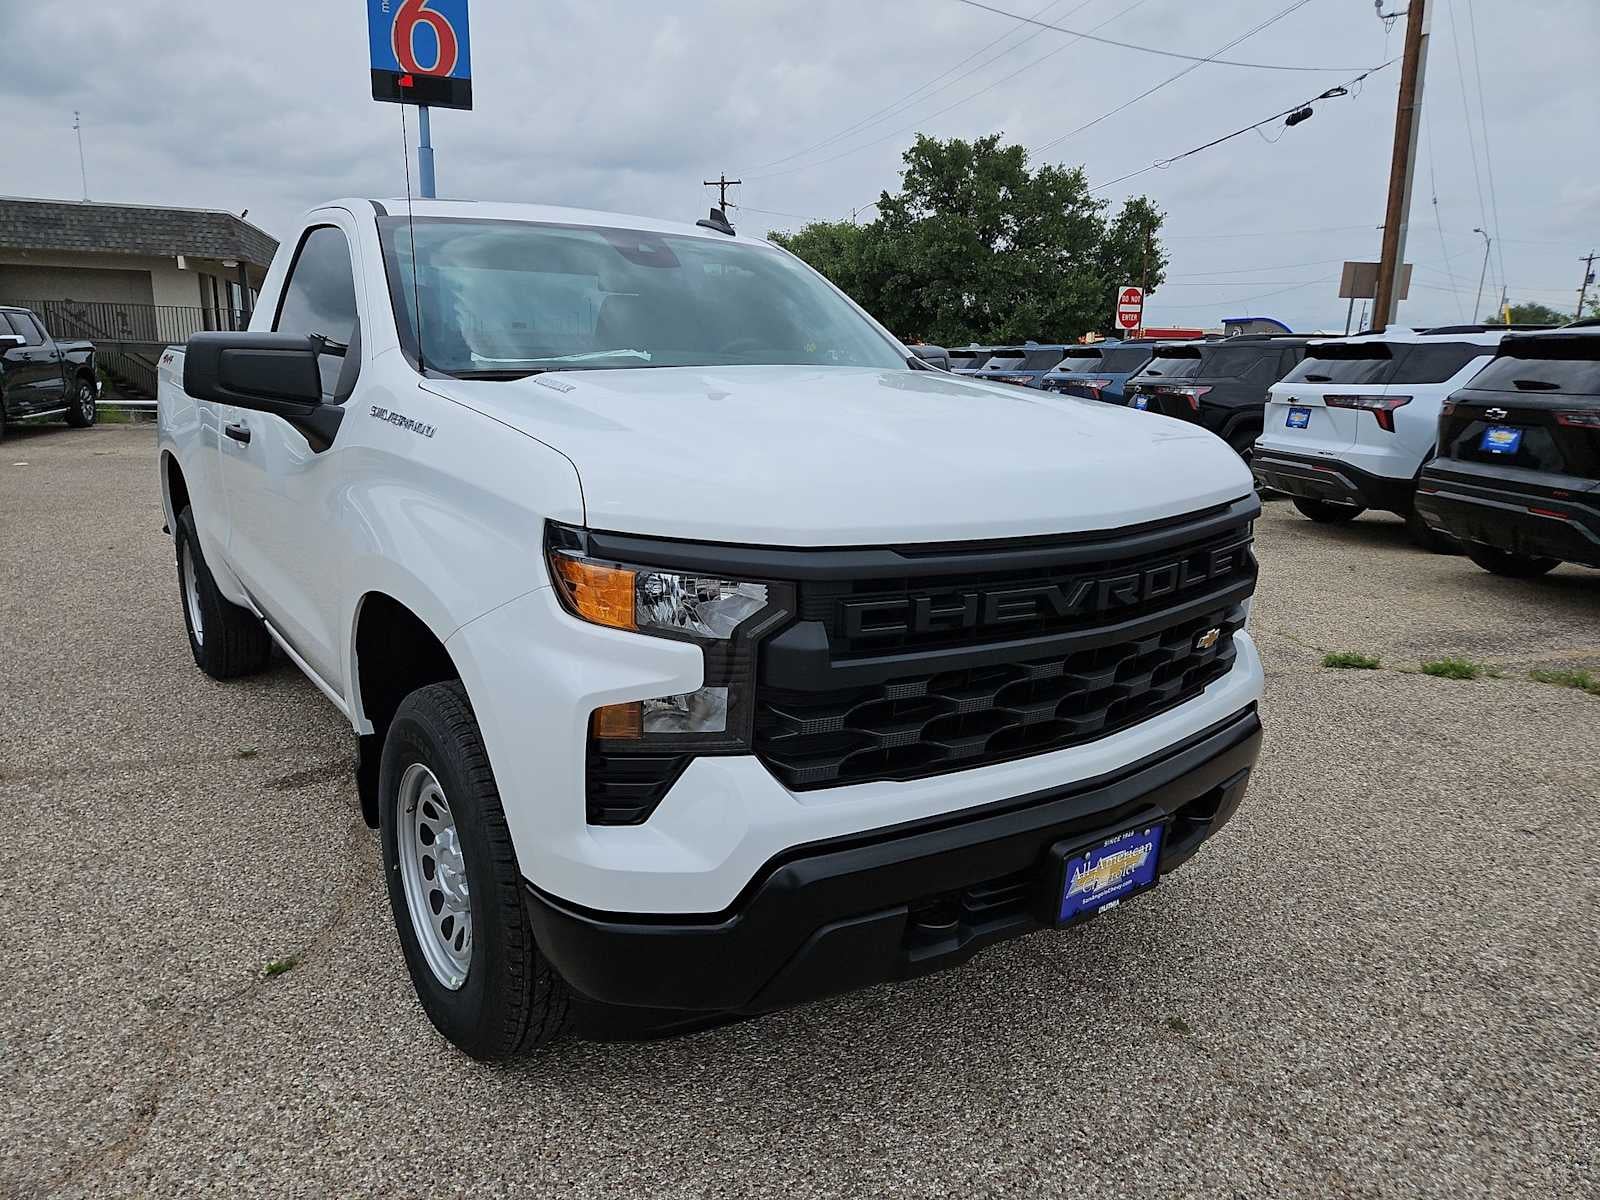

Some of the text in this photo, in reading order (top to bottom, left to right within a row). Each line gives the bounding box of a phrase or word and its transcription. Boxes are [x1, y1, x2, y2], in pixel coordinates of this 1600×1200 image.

[391, 0, 459, 77] 6
[1121, 295, 1141, 303] DO NOT
[1122, 313, 1137, 321] ENTER
[369, 405, 437, 438] SILVERADO
[1071, 842, 1153, 881] All American
[1082, 862, 1137, 893] Chevrolet
